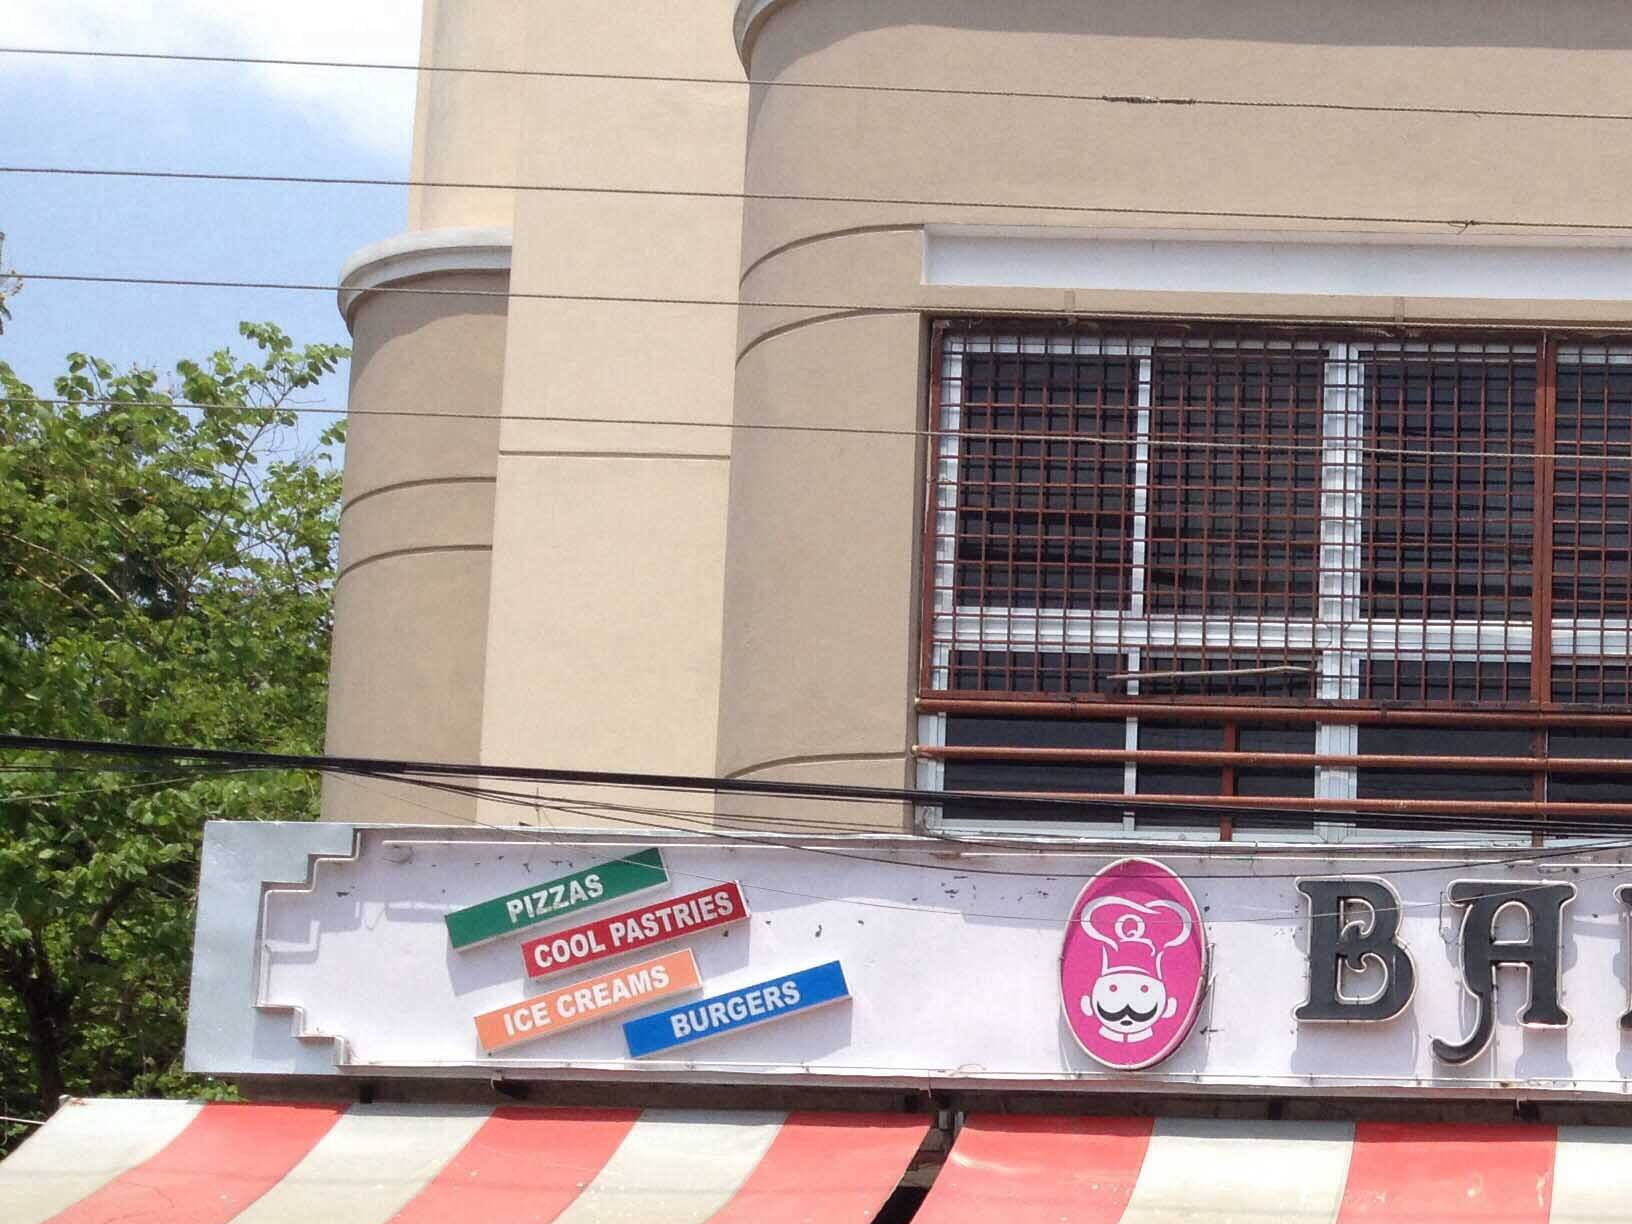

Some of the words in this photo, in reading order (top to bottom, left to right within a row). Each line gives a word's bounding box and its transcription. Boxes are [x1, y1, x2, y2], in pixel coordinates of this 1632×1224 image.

[506, 873, 604, 924] PIZZAS
[533, 930, 606, 969] COOL
[609, 890, 734, 947] PASTRIES
[503, 1007, 551, 1036] ICE
[556, 964, 670, 1018] CREAMS
[670, 980, 801, 1039] BURGERS
